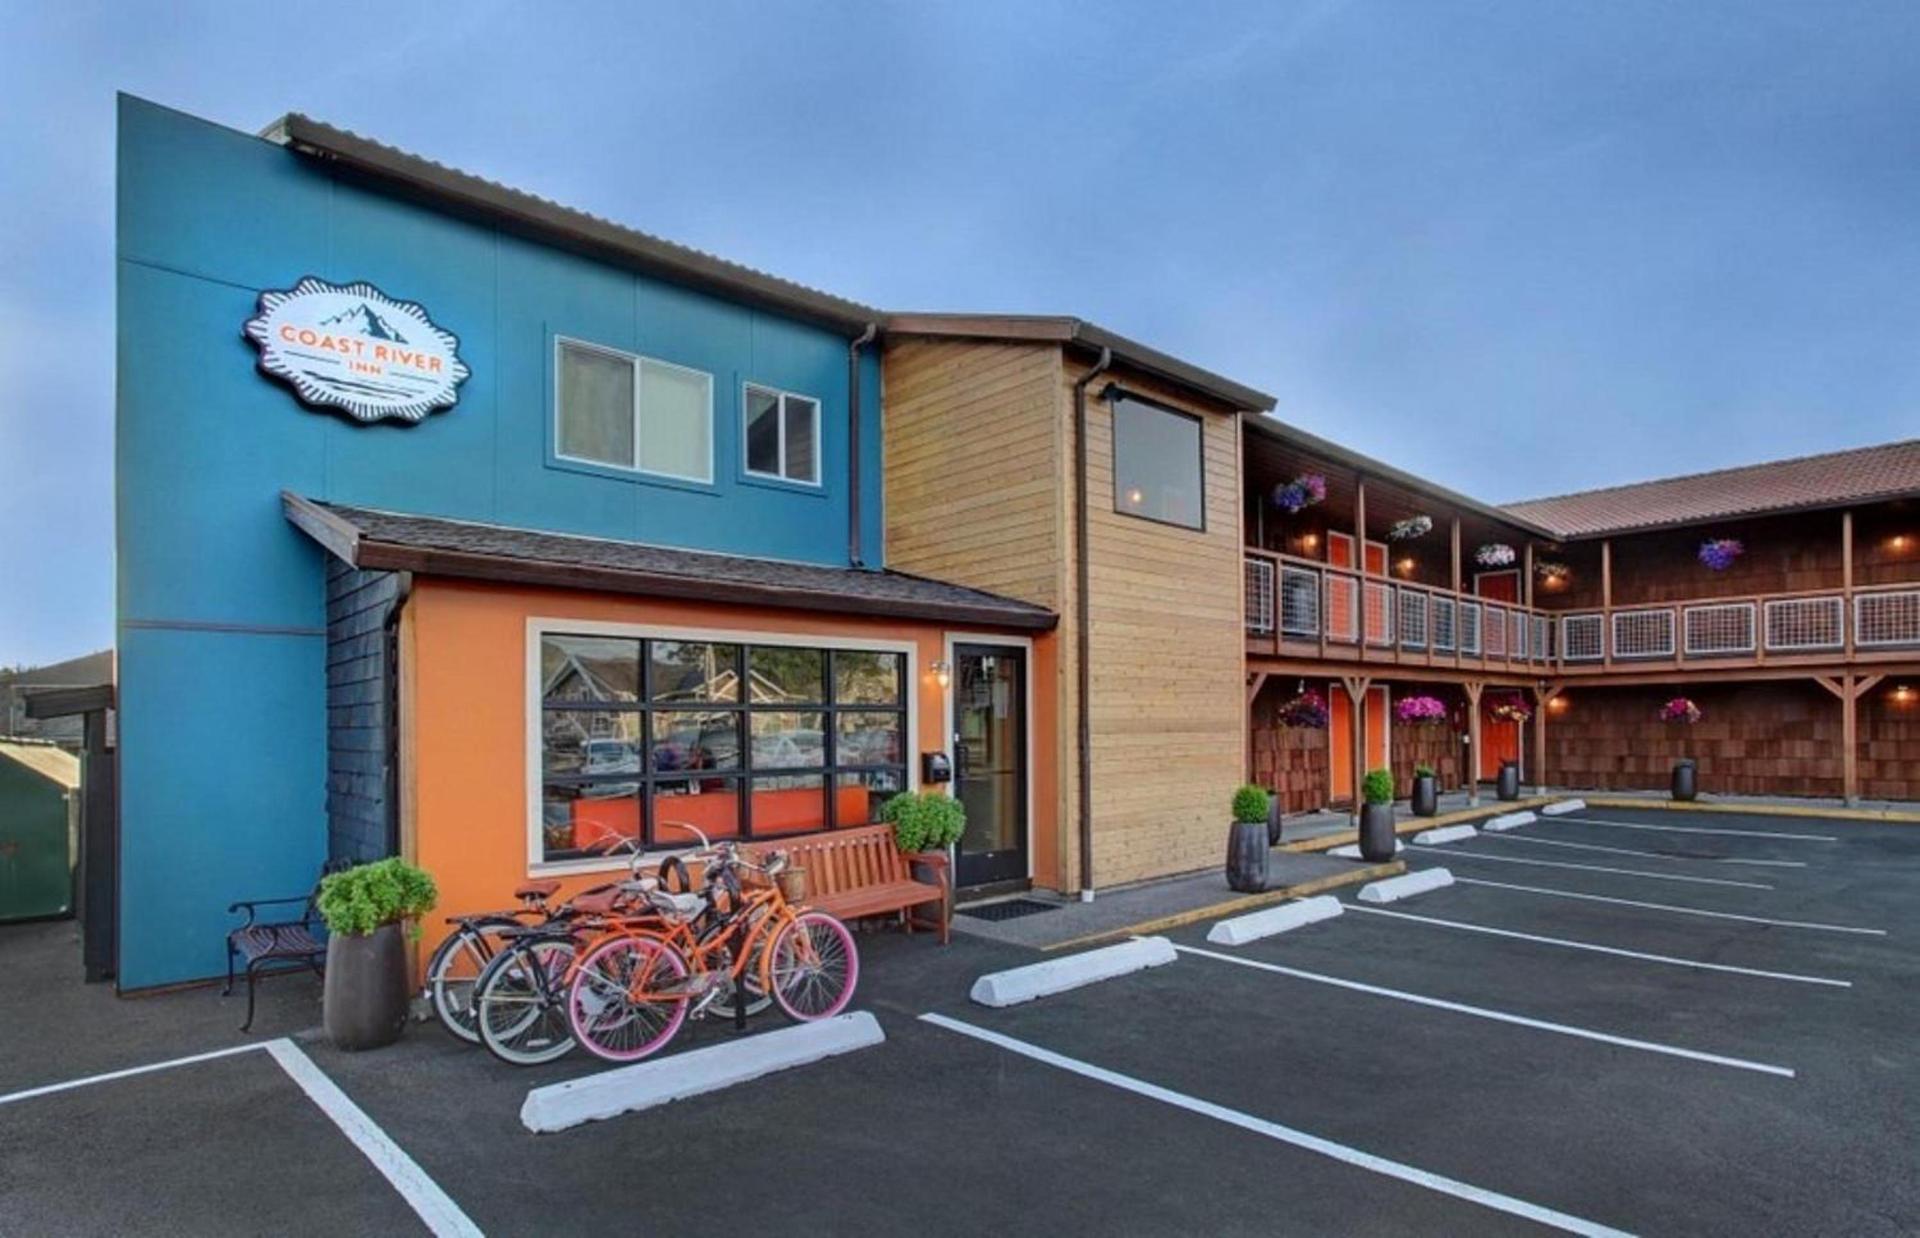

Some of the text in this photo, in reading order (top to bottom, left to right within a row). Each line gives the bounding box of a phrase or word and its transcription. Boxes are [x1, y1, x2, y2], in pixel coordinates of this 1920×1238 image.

[280, 325, 443, 373] COAST RIVER
[348, 360, 382, 375] INN
